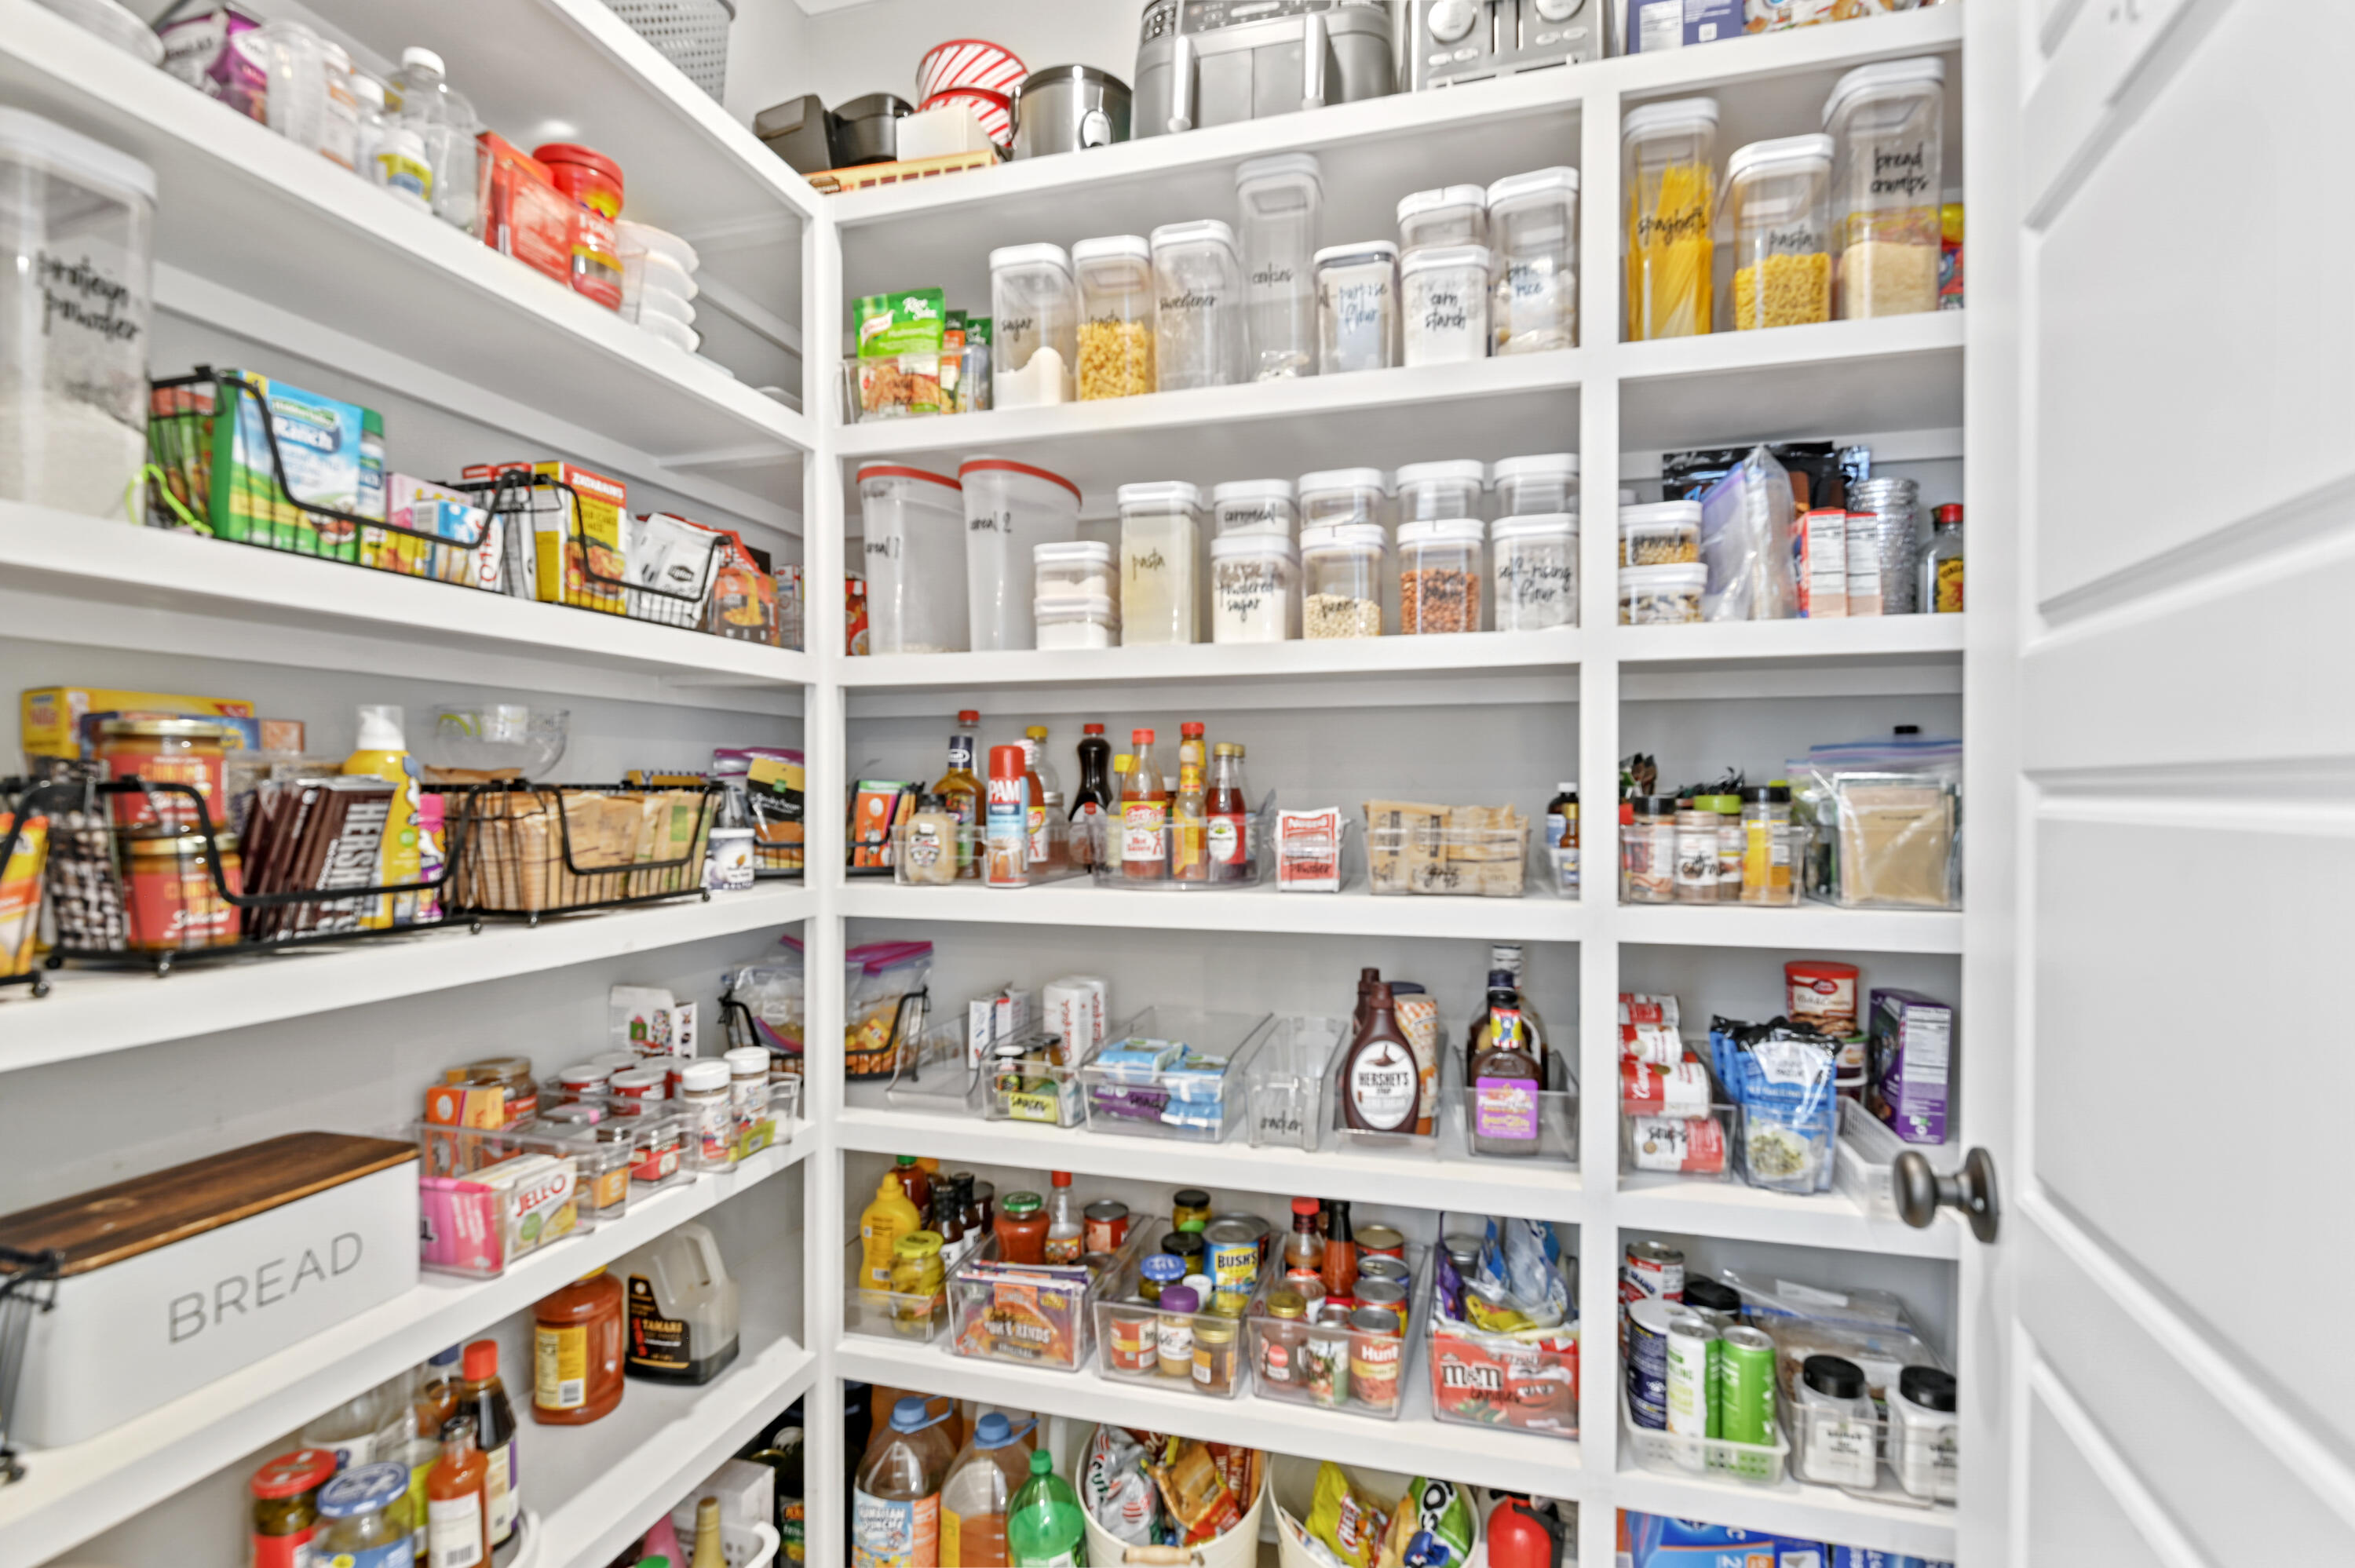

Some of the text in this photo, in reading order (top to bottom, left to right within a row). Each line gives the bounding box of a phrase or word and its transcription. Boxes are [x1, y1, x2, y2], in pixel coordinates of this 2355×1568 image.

[988, 779, 1020, 802] PAM
[1358, 1071, 1409, 1087] HERSHEY'S
[1218, 1251, 1258, 1269] BUSH'S
[168, 1231, 363, 1344] BREAD
[642, 1318, 683, 1333] TAMARI
